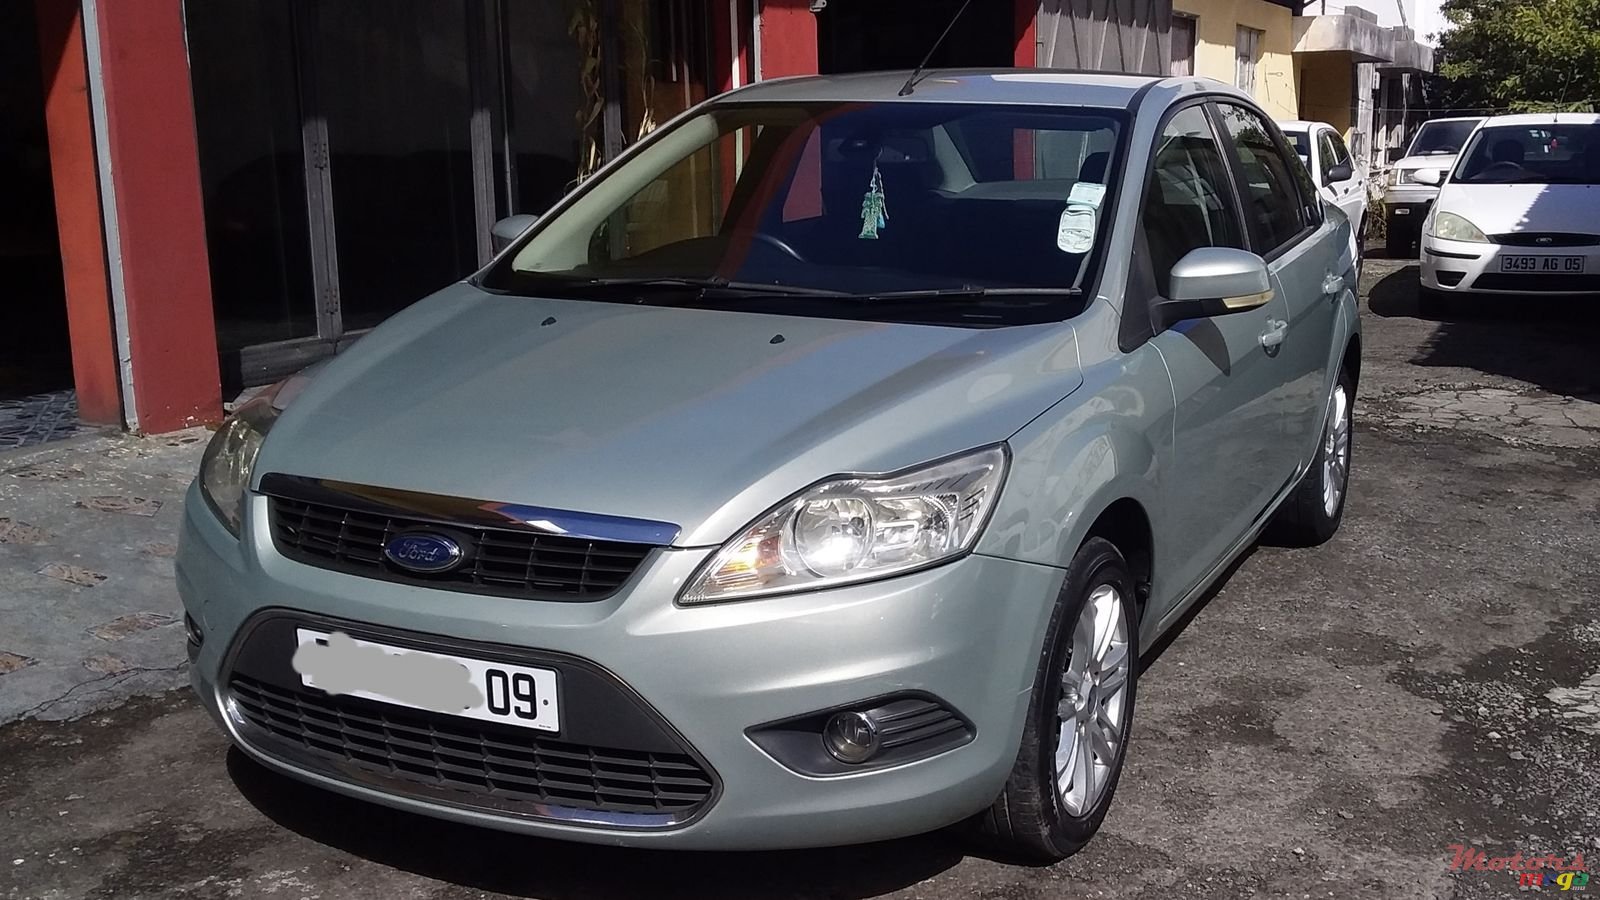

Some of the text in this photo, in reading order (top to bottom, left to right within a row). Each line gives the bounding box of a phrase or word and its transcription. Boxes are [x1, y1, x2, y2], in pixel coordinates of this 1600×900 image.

[1504, 257, 1581, 270] 3493 AG 05
[396, 537, 438, 561] Ford
[485, 668, 537, 720] 09
